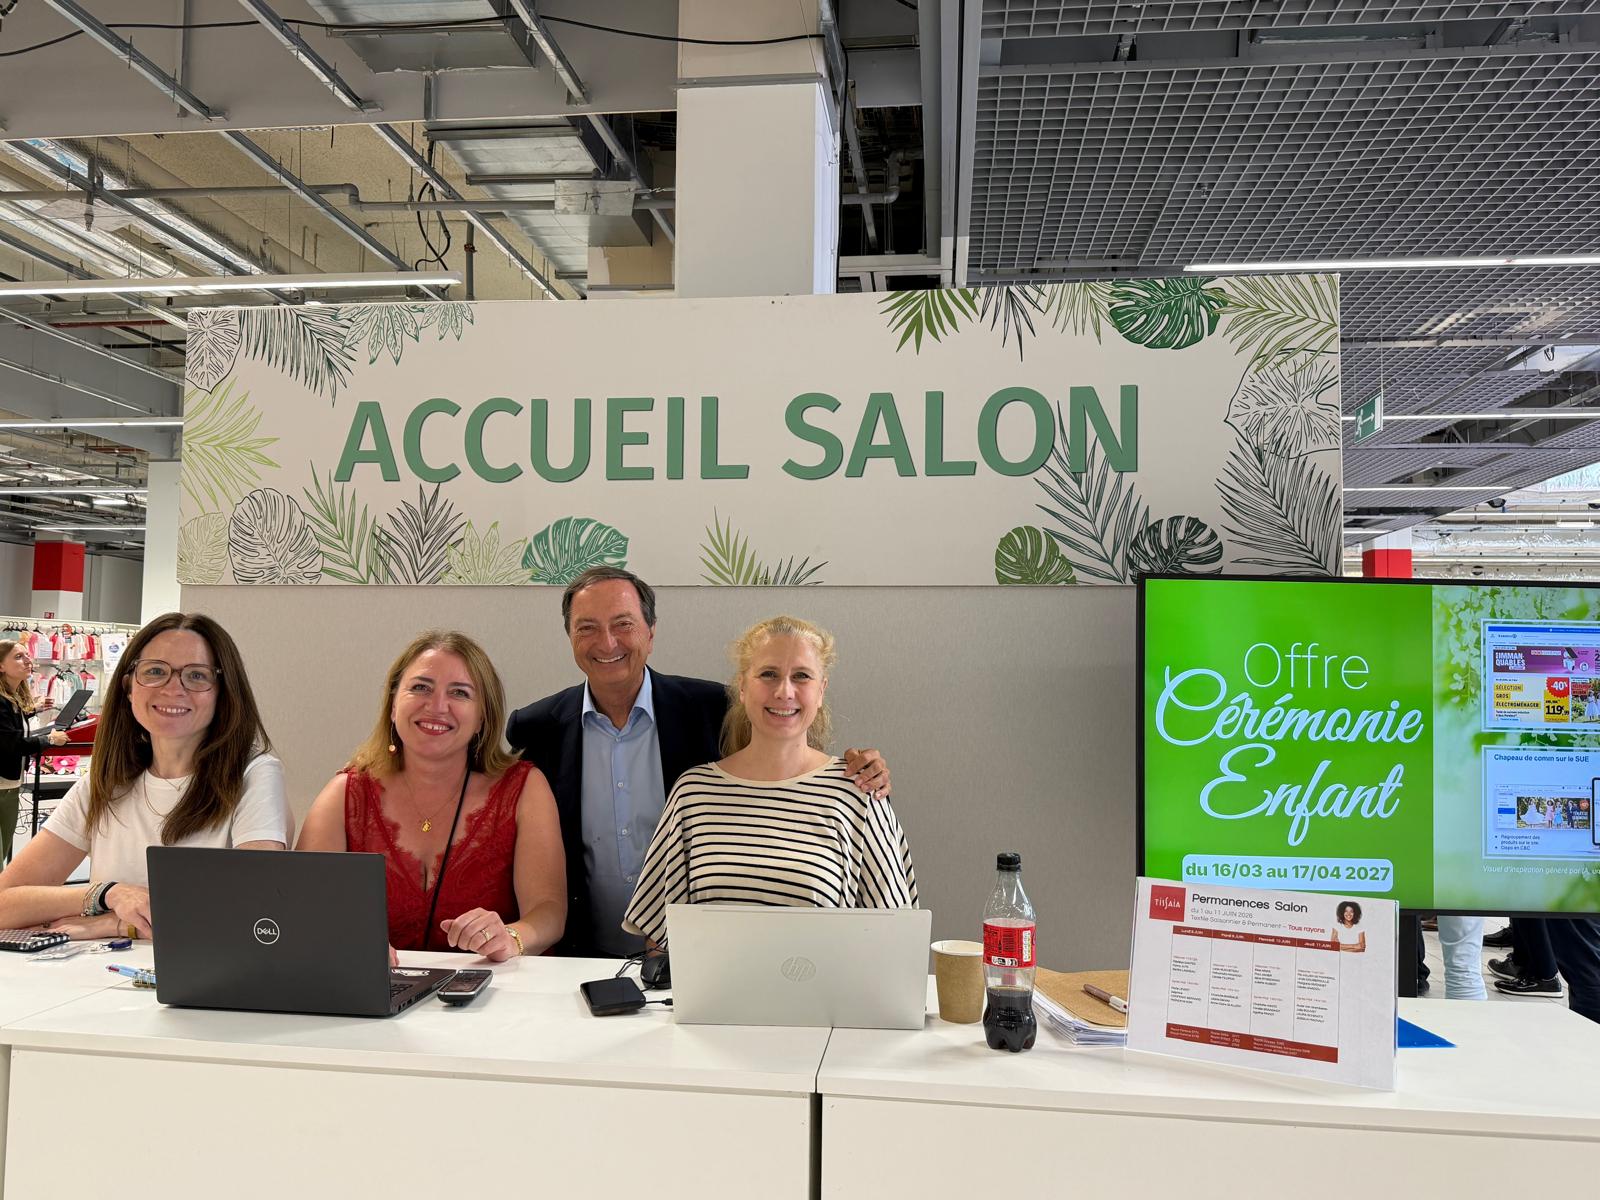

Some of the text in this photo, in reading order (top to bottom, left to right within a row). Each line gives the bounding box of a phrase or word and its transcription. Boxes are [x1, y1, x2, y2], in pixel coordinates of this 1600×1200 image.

[334, 384, 1139, 484] ACCUEIL SALON
[1244, 642, 1369, 690] Offre
[1155, 665, 1424, 747] Cérémonie
[1494, 754, 1524, 763] Chapeau
[1199, 743, 1405, 847] Enfant
[1185, 862, 1391, 881] du 16/03 au 17/04 2027
[1483, 865, 1503, 873] Visuel
[1192, 893, 1308, 913] Permanences Salon
[1222, 910, 1237, 918] JUIN
[256, 927, 277, 935] DELL
[1191, 914, 1208, 922] Textile
[1209, 916, 1241, 925] Saisonnier
[1247, 920, 1281, 929] Permanent
[1288, 924, 1302, 932] Tous
[1303, 926, 1325, 935] rayons
[785, 956, 813, 983] hp
